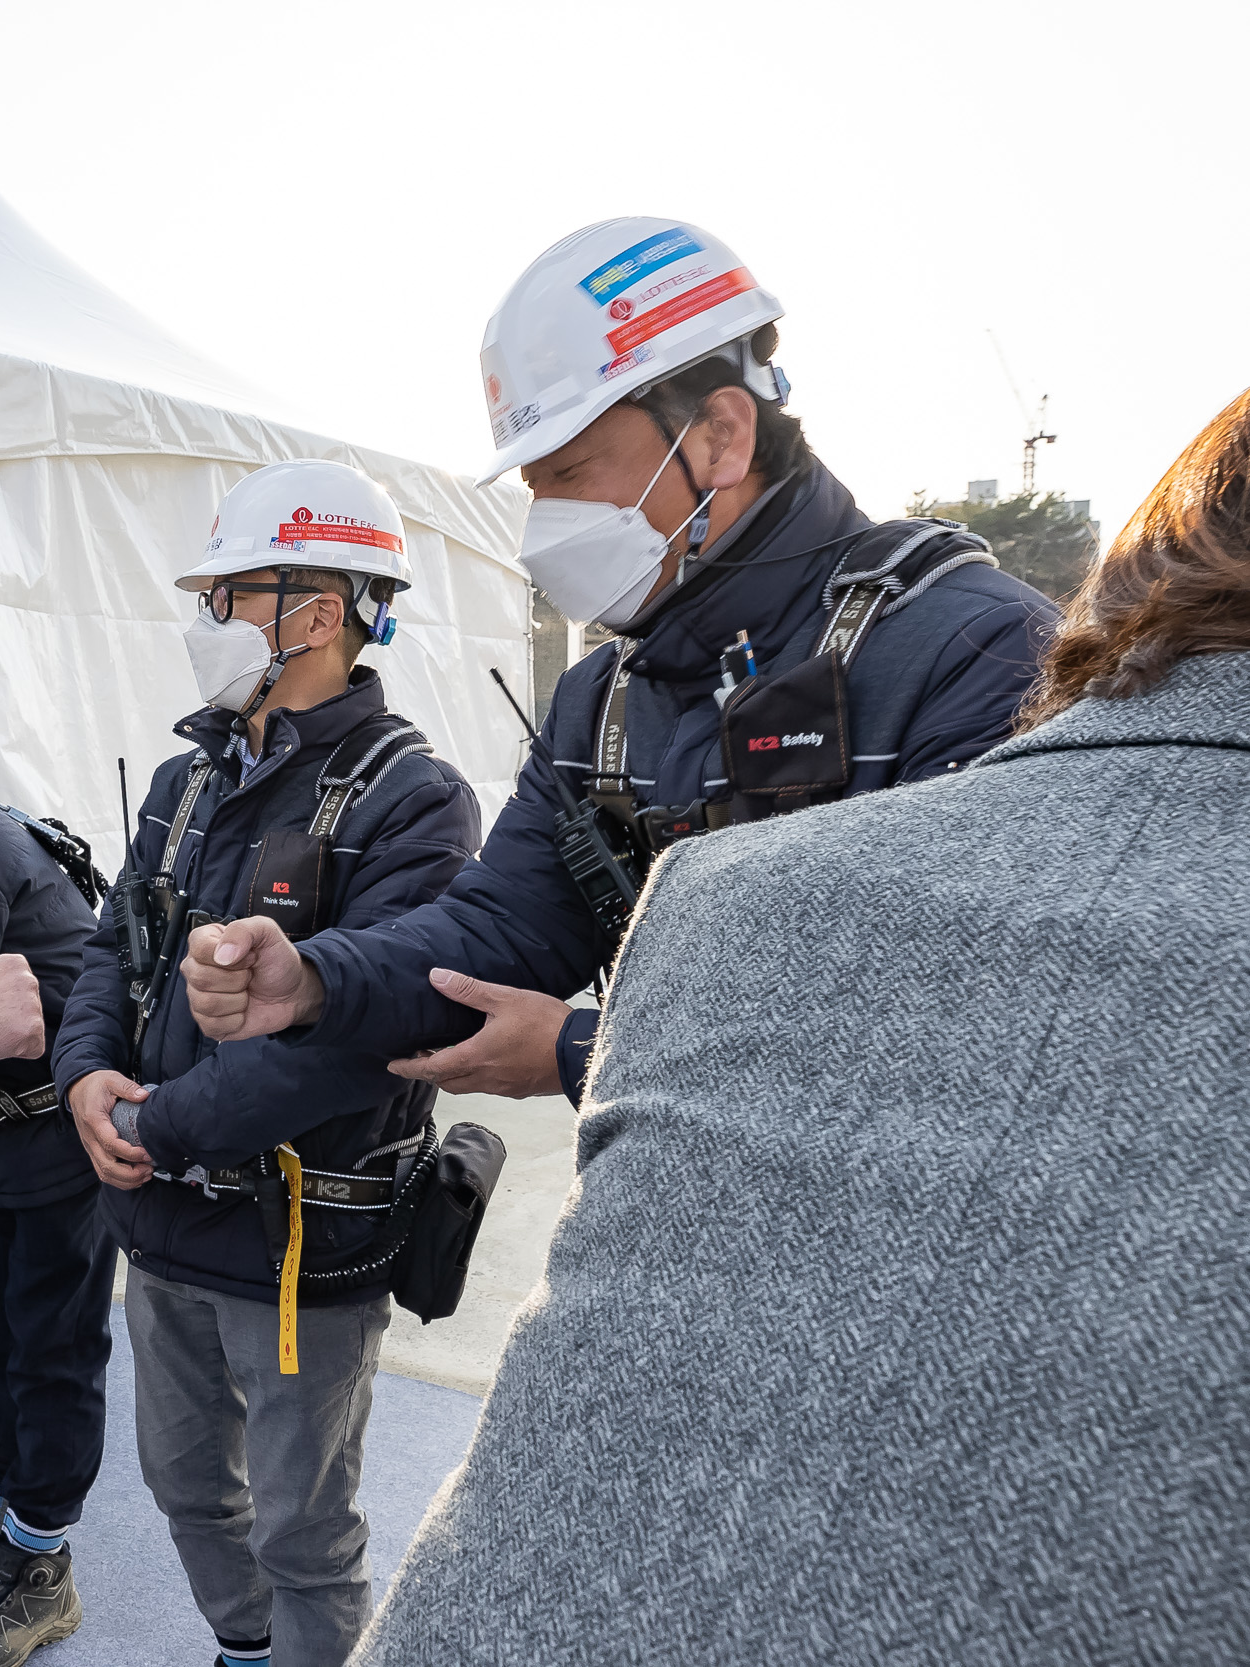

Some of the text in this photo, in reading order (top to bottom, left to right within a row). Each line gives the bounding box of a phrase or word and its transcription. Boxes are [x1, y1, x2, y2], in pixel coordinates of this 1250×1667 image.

[317, 513, 358, 526] LOTTE
[748, 732, 824, 752] K2 Safety
[180, 784, 195, 818] Think
[315, 811, 333, 837] hink
[272, 881, 290, 894] K2
[262, 896, 299, 908] Think Safety
[316, 1178, 351, 1200] K2
